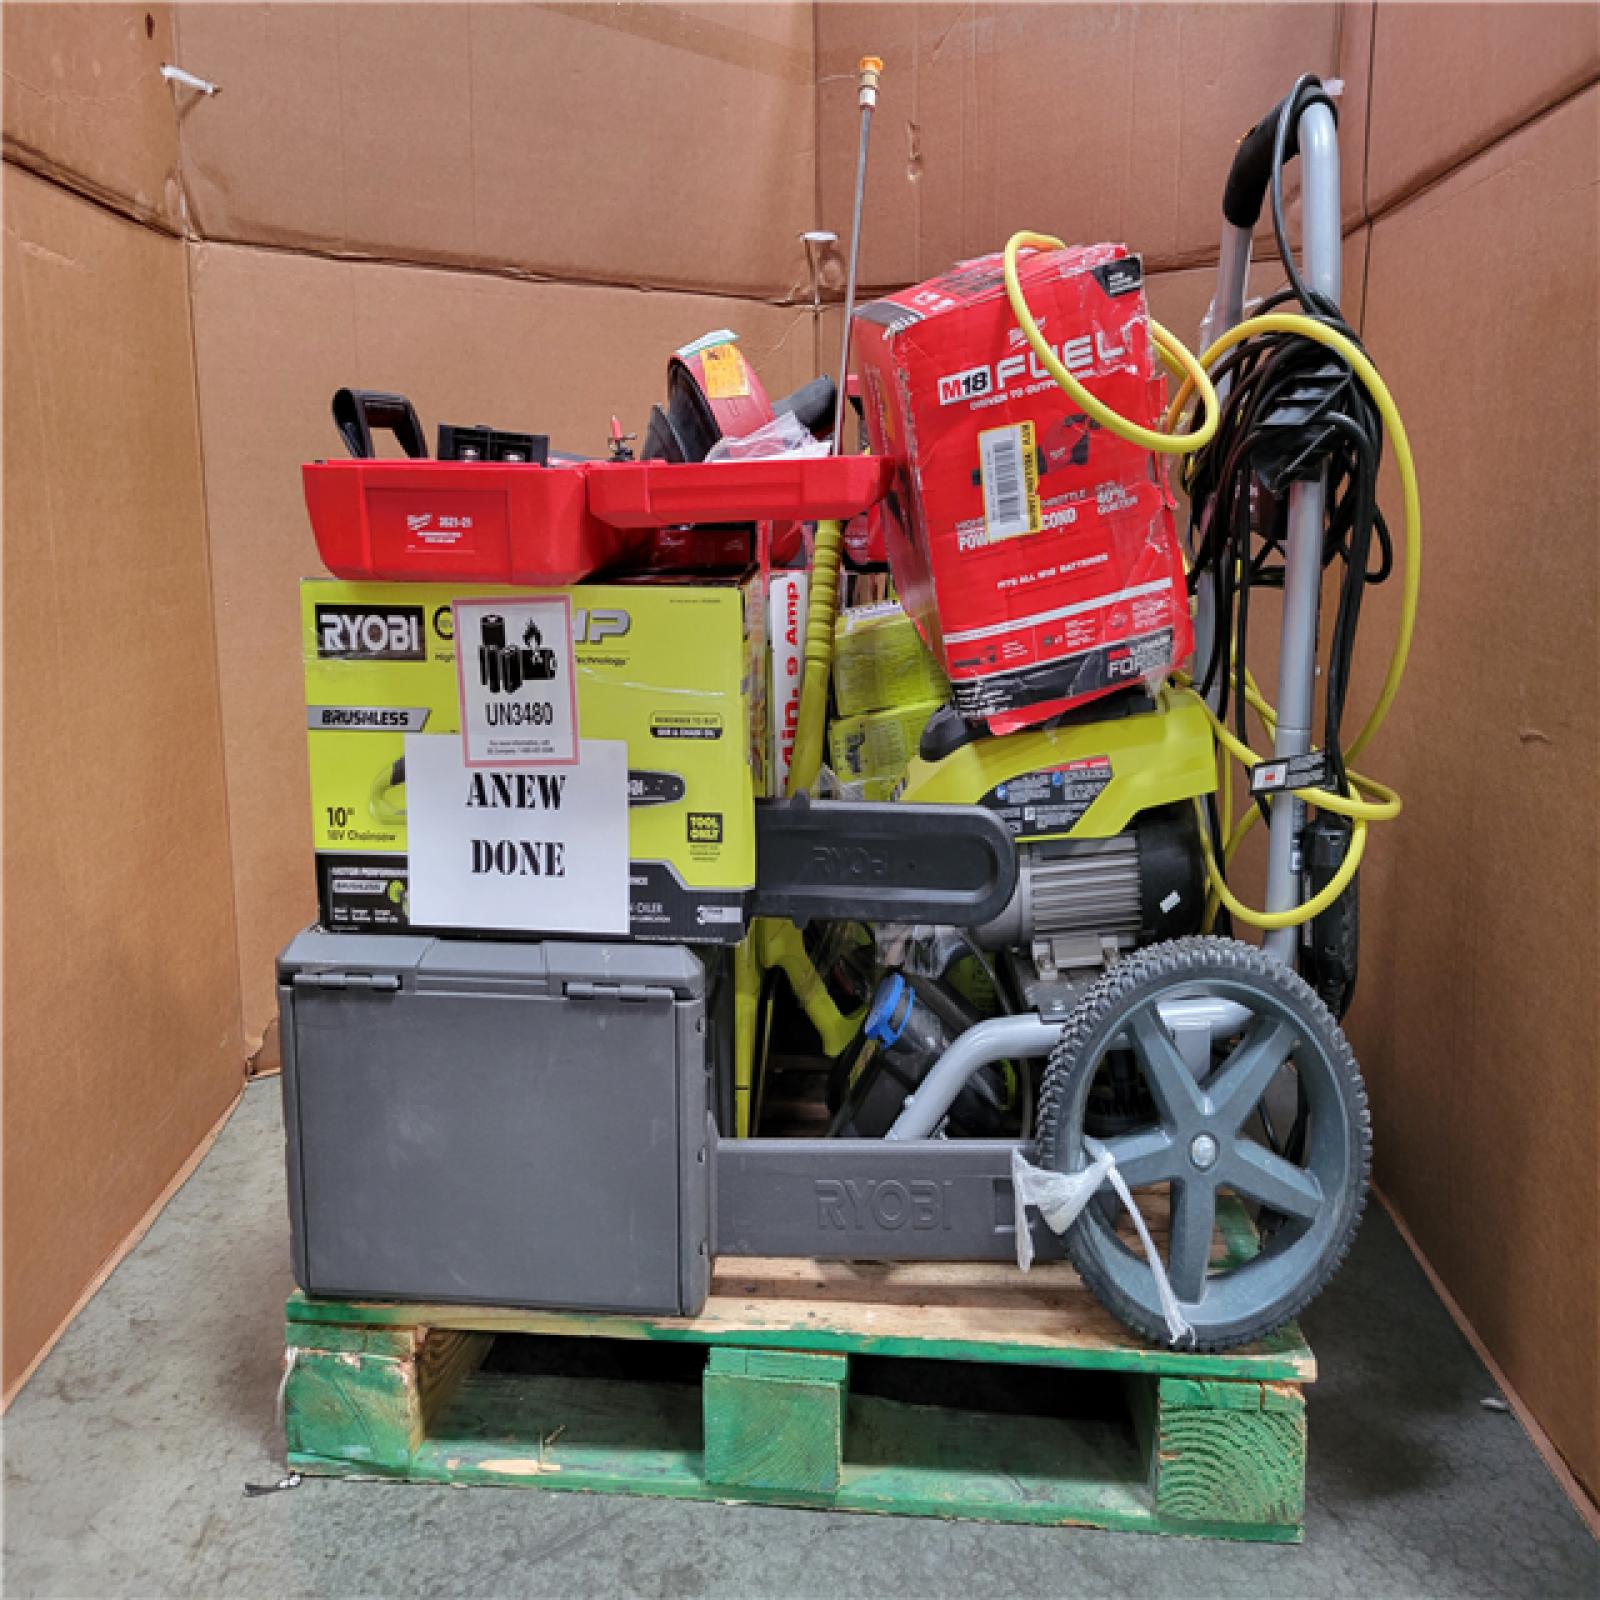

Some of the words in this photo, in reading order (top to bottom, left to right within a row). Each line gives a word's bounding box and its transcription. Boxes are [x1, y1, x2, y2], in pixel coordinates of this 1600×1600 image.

[941, 369, 990, 402] M18
[997, 332, 1125, 388] FUEL
[318, 613, 419, 652] RYOBI
[784, 581, 799, 646] Amp
[321, 709, 409, 726] BRUSHLESS
[485, 701, 554, 727] UN3480
[465, 772, 567, 811] ANEW
[347, 830, 396, 843] Chainsaw
[471, 839, 566, 878] DONE
[814, 1178, 953, 1231] RYOBI
